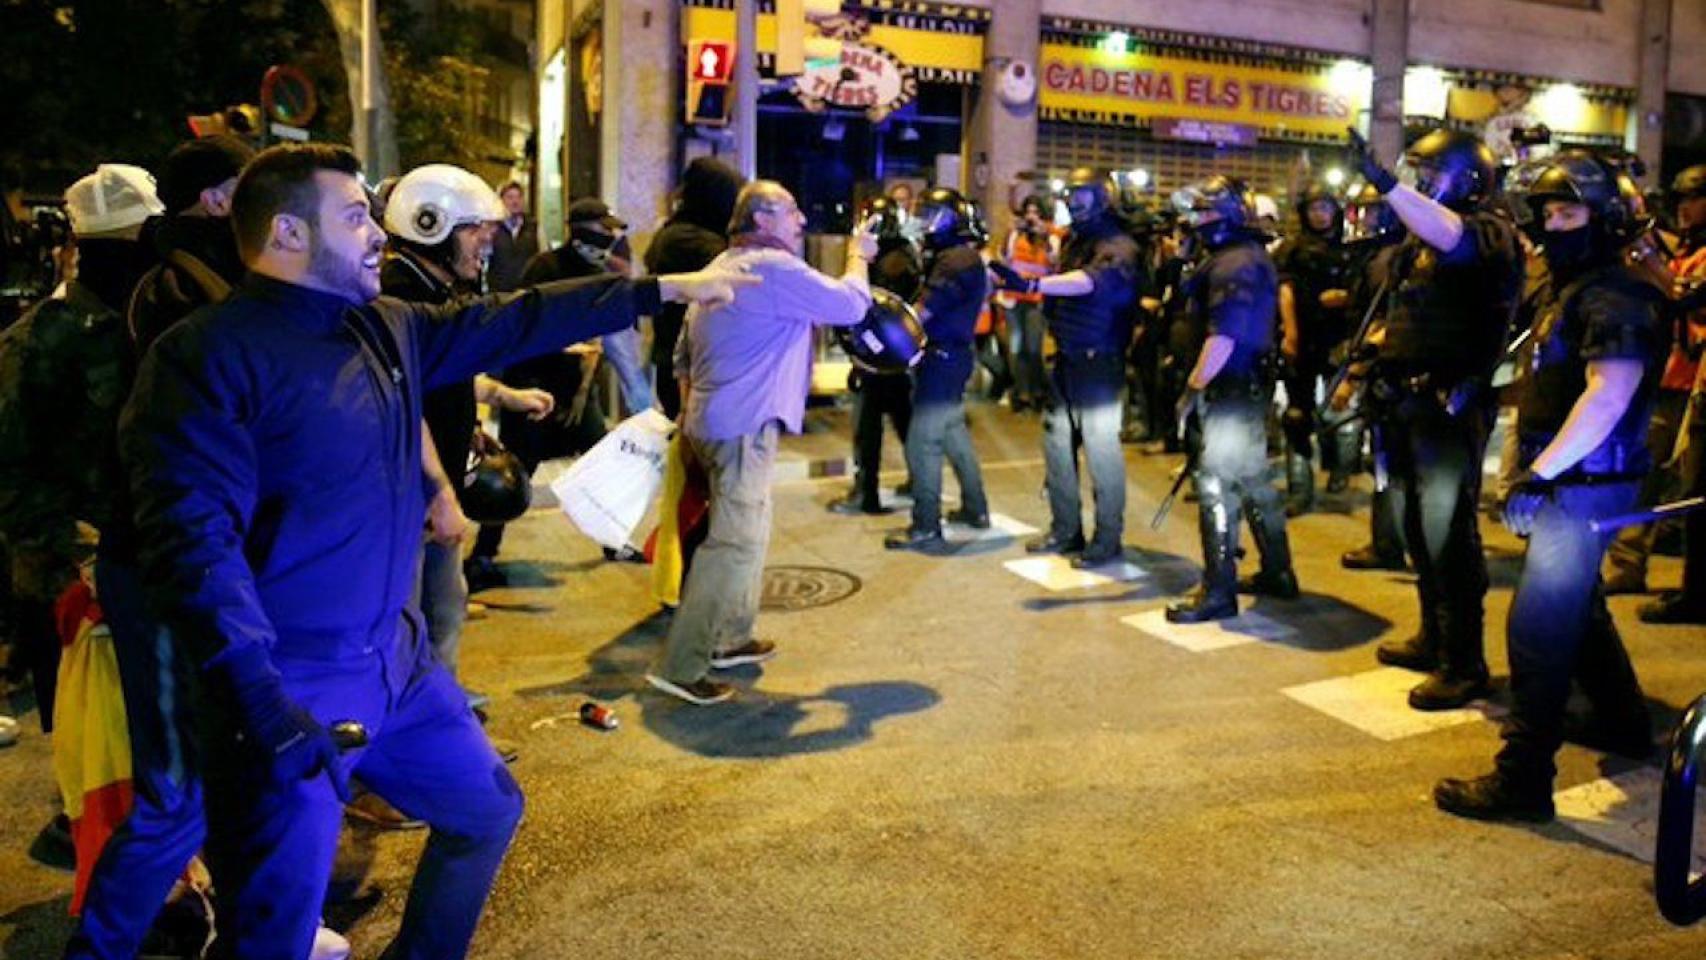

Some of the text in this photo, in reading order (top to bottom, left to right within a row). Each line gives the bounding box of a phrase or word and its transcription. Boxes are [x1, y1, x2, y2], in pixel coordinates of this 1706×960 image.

[841, 49, 883, 76] DENA
[1044, 62, 1349, 118] CADENA ELS TIGRES
